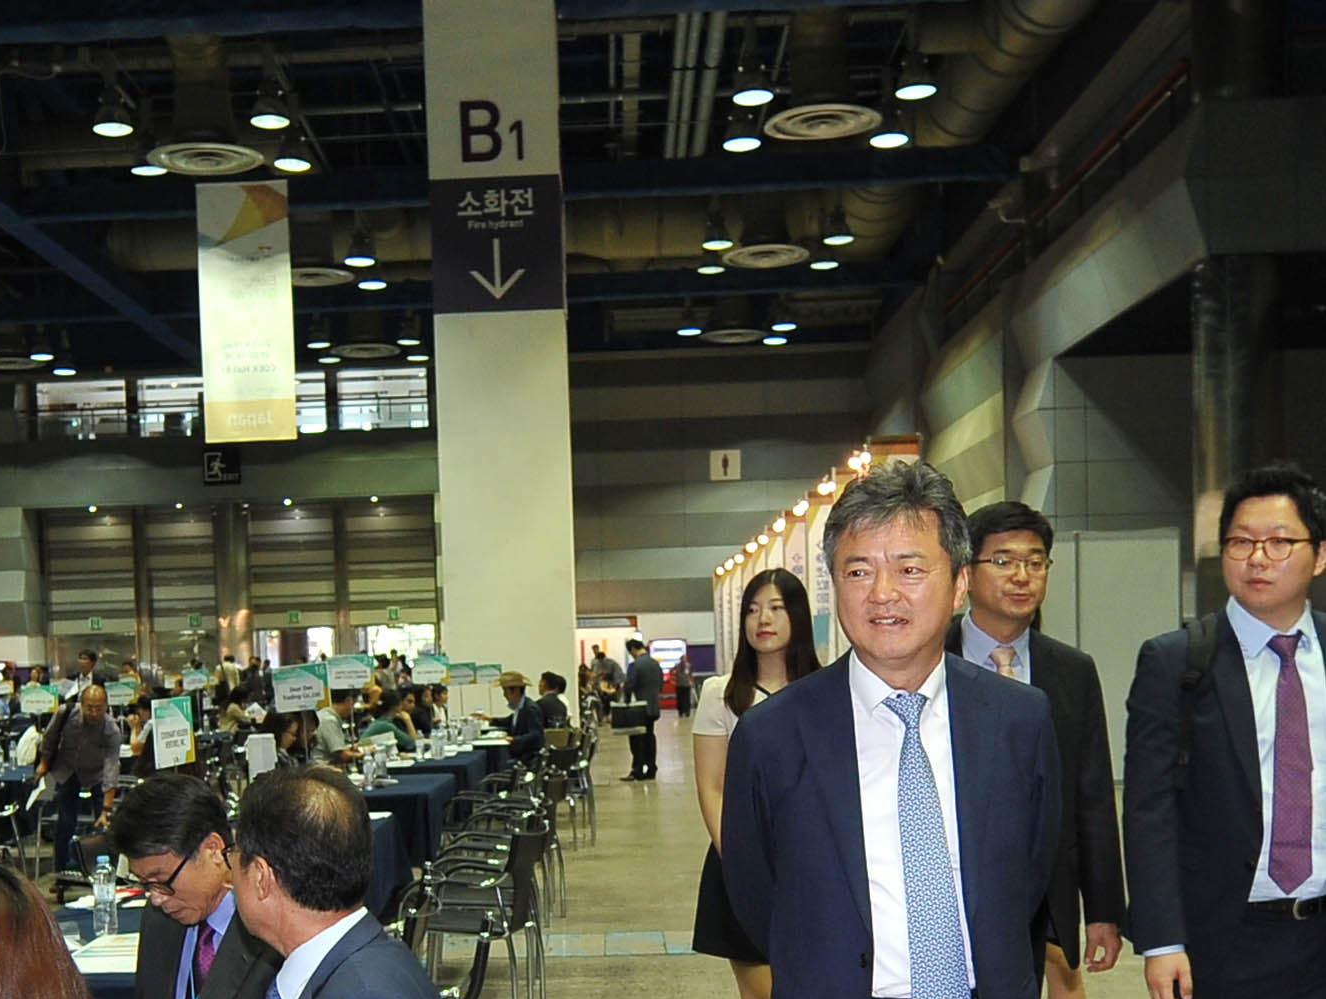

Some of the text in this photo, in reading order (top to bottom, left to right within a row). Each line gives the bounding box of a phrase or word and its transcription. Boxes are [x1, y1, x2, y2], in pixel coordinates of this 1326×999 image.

[459, 100, 524, 163] B1
[457, 187, 534, 217] 소화전
[467, 218, 524, 231] Fire hydrant
